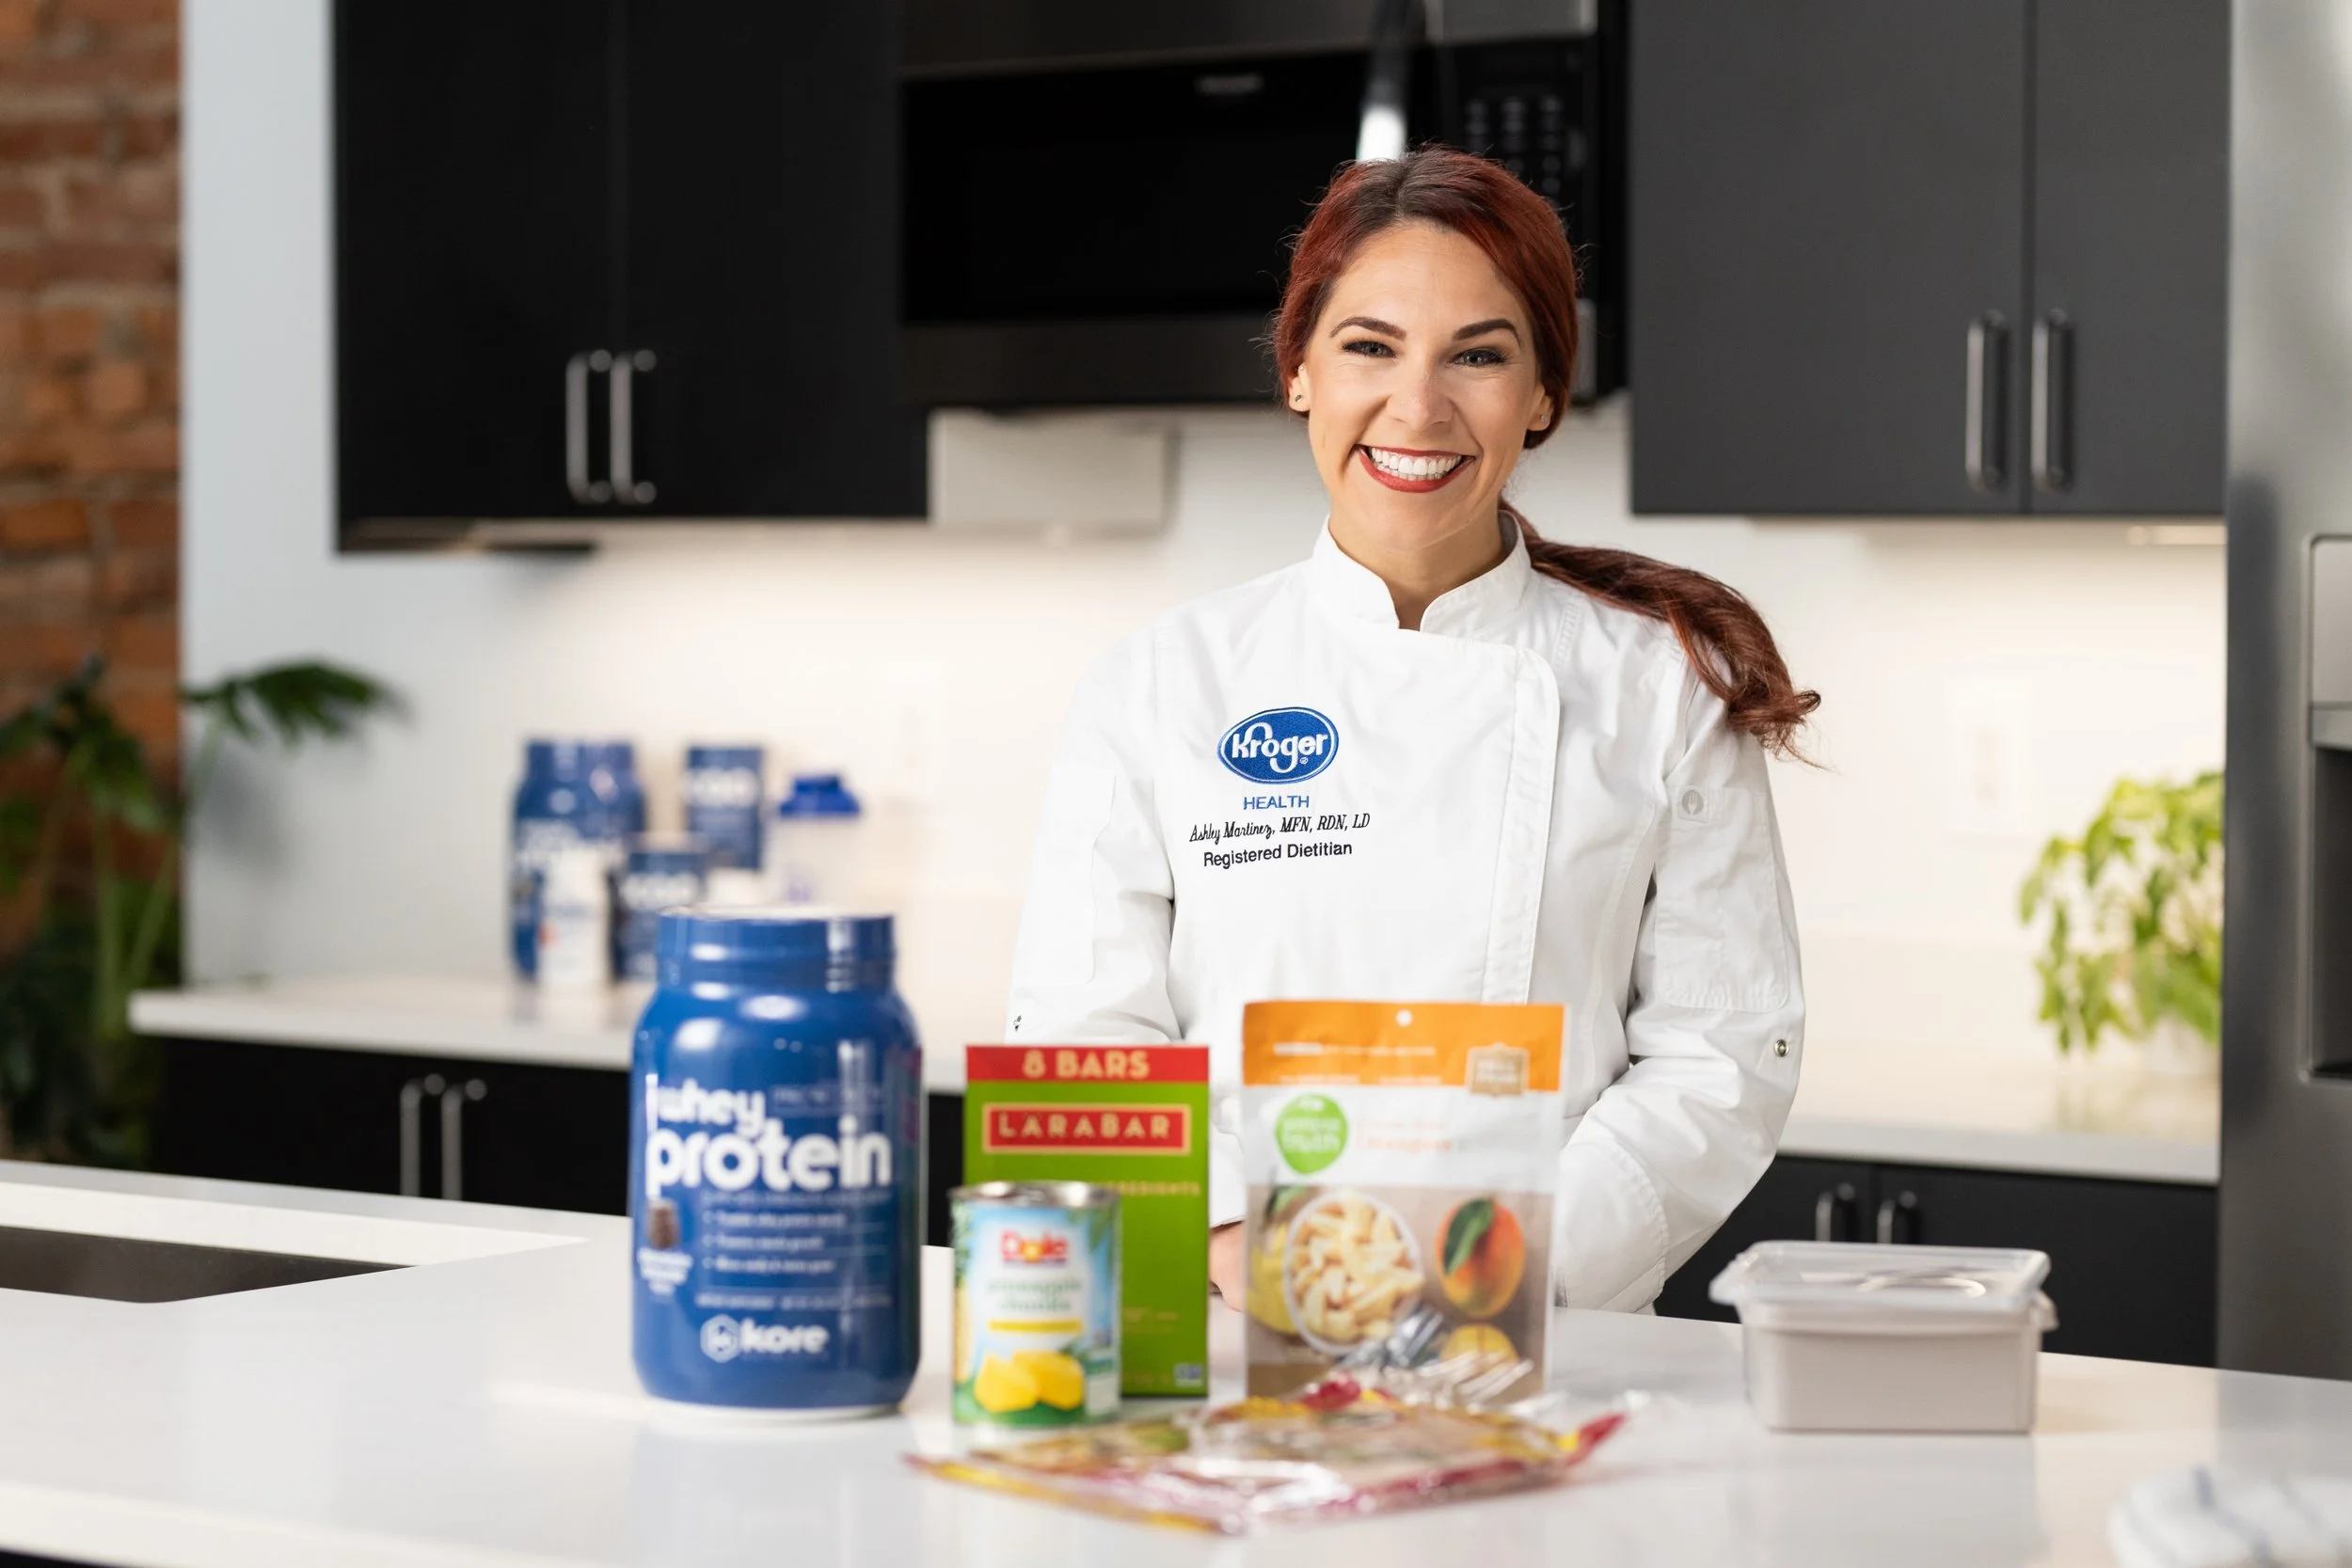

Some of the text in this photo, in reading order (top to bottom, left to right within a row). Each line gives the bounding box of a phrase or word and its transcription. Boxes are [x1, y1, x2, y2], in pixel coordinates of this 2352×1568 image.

[1232, 721, 1328, 773] Kroger
[1243, 796, 1310, 810] HEALTH
[1189, 813, 1371, 845] Ashley Martinez, MFN, RDN, LD
[1203, 842, 1352, 869] Registered Dietitian
[1023, 1049, 1150, 1079] 8 BARS
[658, 1078, 766, 1137] whey
[998, 1111, 1170, 1138] LARABAR
[645, 1114, 892, 1199] protein
[740, 1318, 829, 1354] kore
